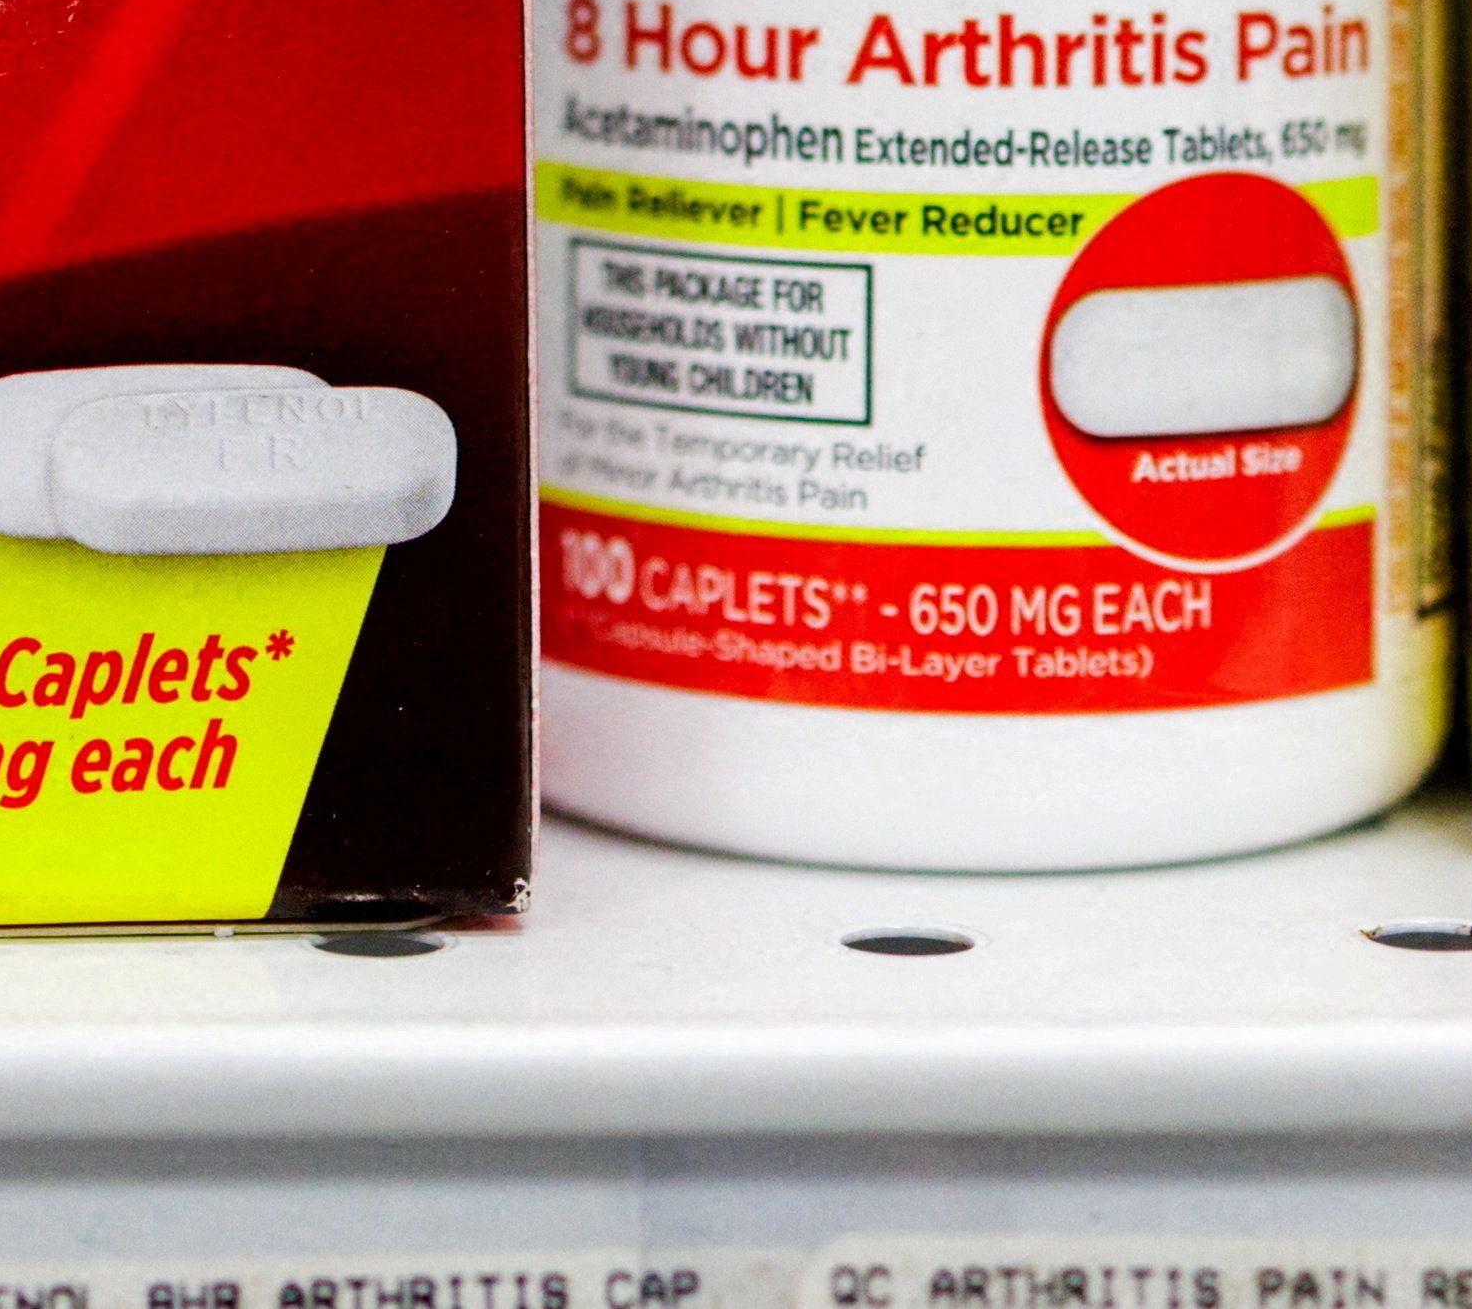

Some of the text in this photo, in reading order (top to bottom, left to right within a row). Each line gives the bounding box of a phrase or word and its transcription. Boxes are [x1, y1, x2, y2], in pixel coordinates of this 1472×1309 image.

[624, 0, 820, 83] Hour
[846, 10, 1209, 88] Arthritis
[1236, 2, 1370, 83] Pain
[855, 126, 1153, 167] Extended-Release
[799, 199, 1086, 239] Fever Reducer
[1131, 443, 1303, 484] Actual Size
[909, 580, 1213, 637] 650 MG EACH
[70, 717, 237, 794] each
[928, 1265, 1222, 1309] ARTHRITIS
[1257, 1266, 1388, 1309] PAIN
